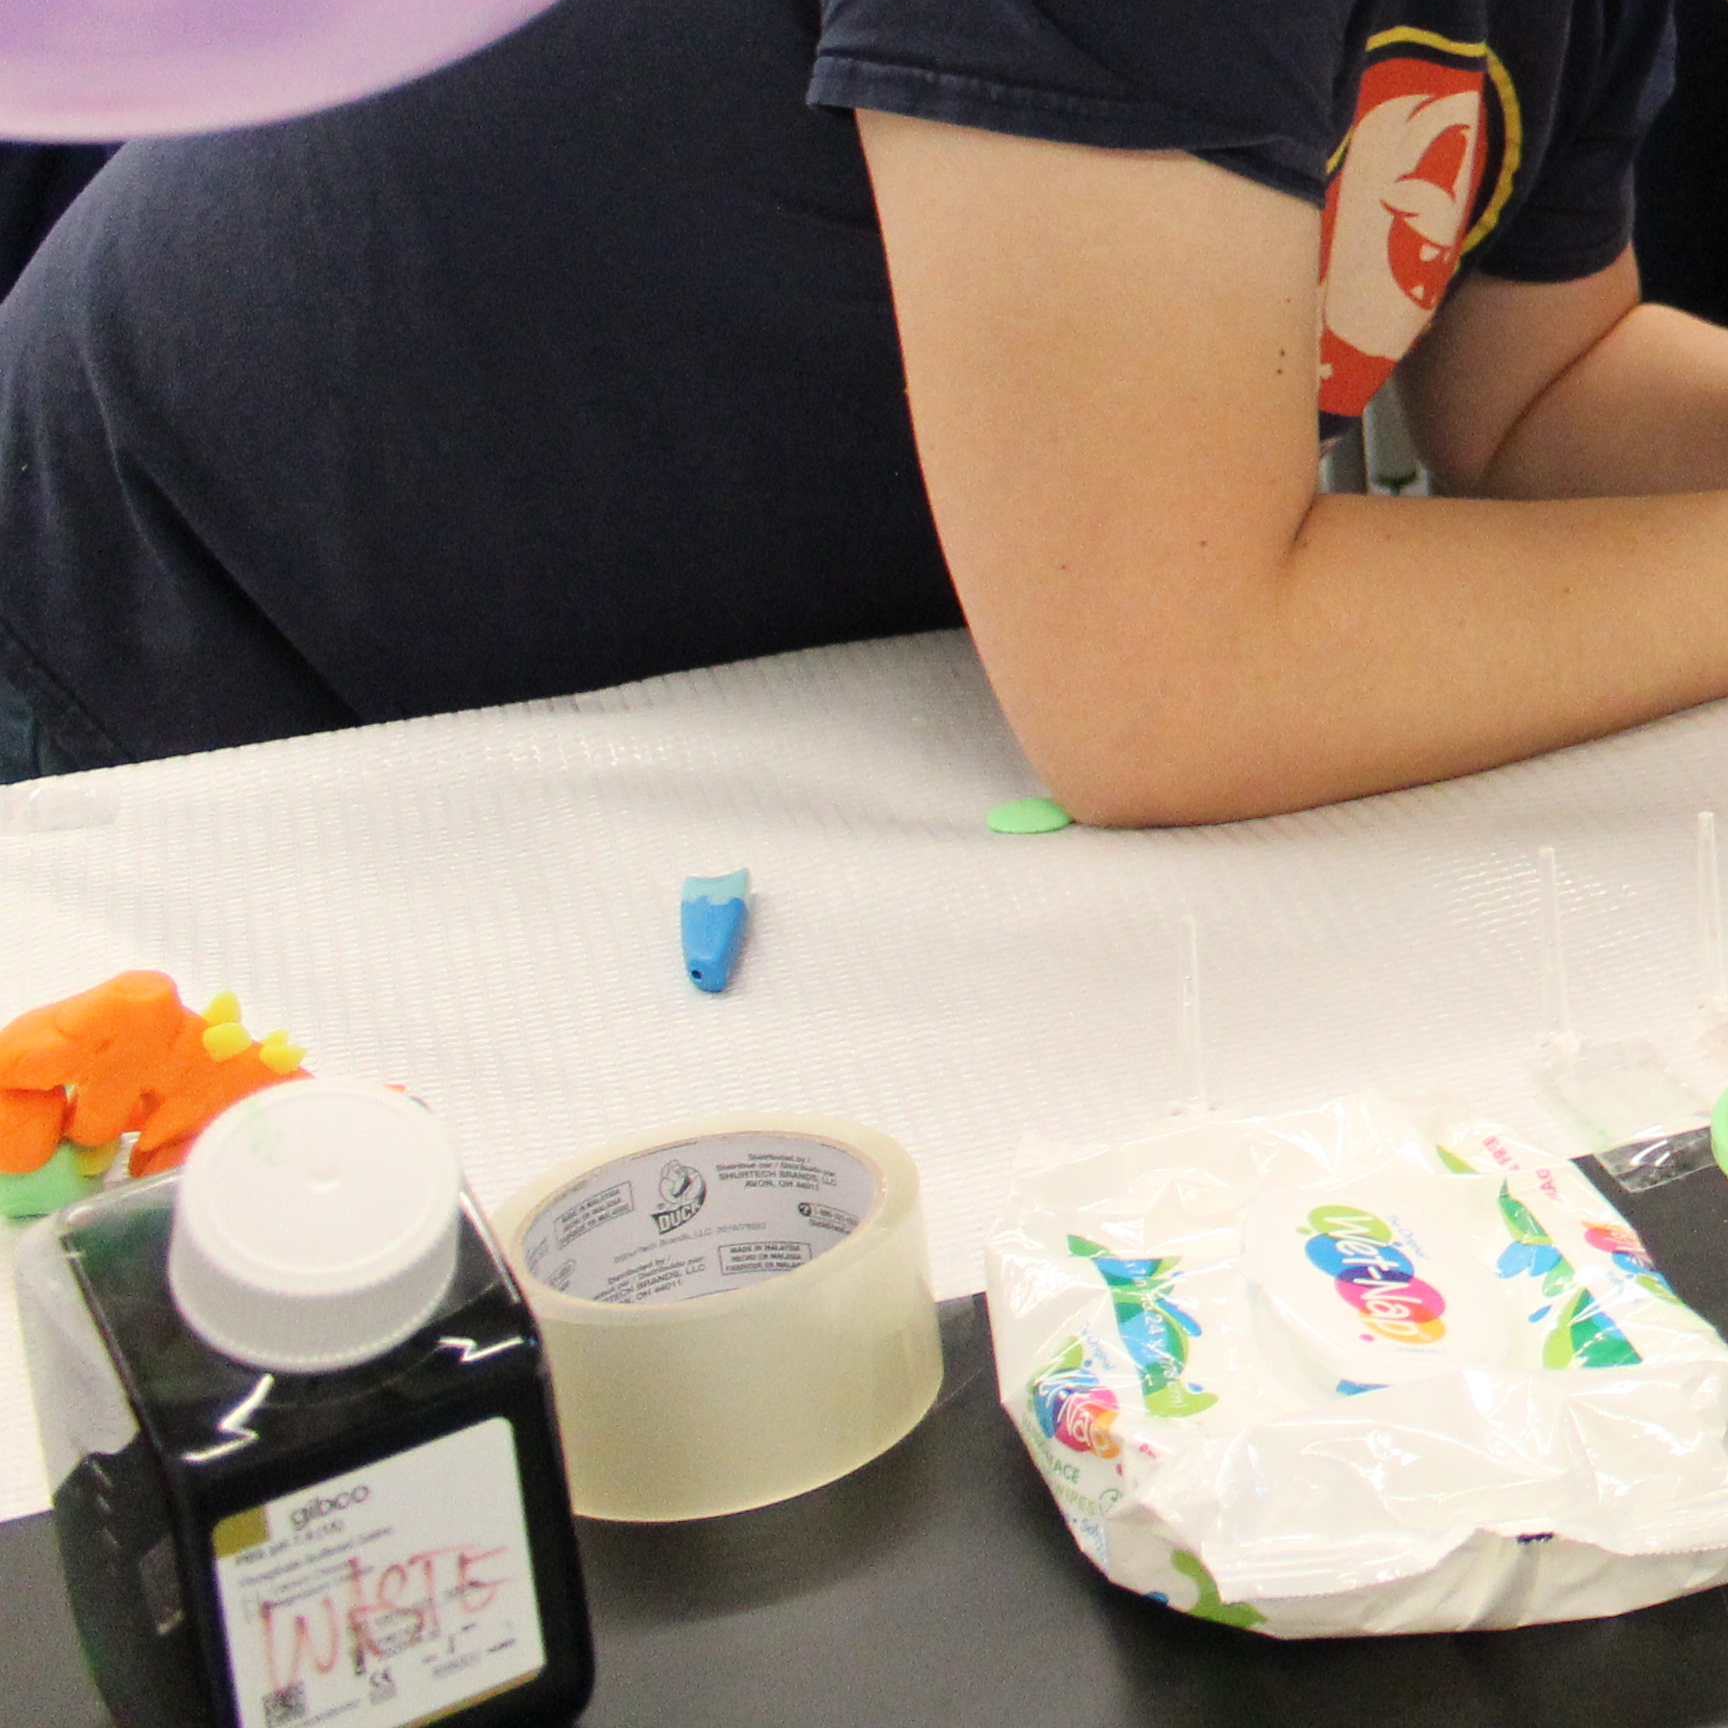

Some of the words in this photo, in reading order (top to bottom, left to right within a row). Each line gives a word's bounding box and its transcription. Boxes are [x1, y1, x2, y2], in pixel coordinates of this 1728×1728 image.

[658, 1200, 700, 1232] DUCK
[1320, 1212, 1427, 1339] Wet-Nap
[290, 1484, 371, 1531] gibco
